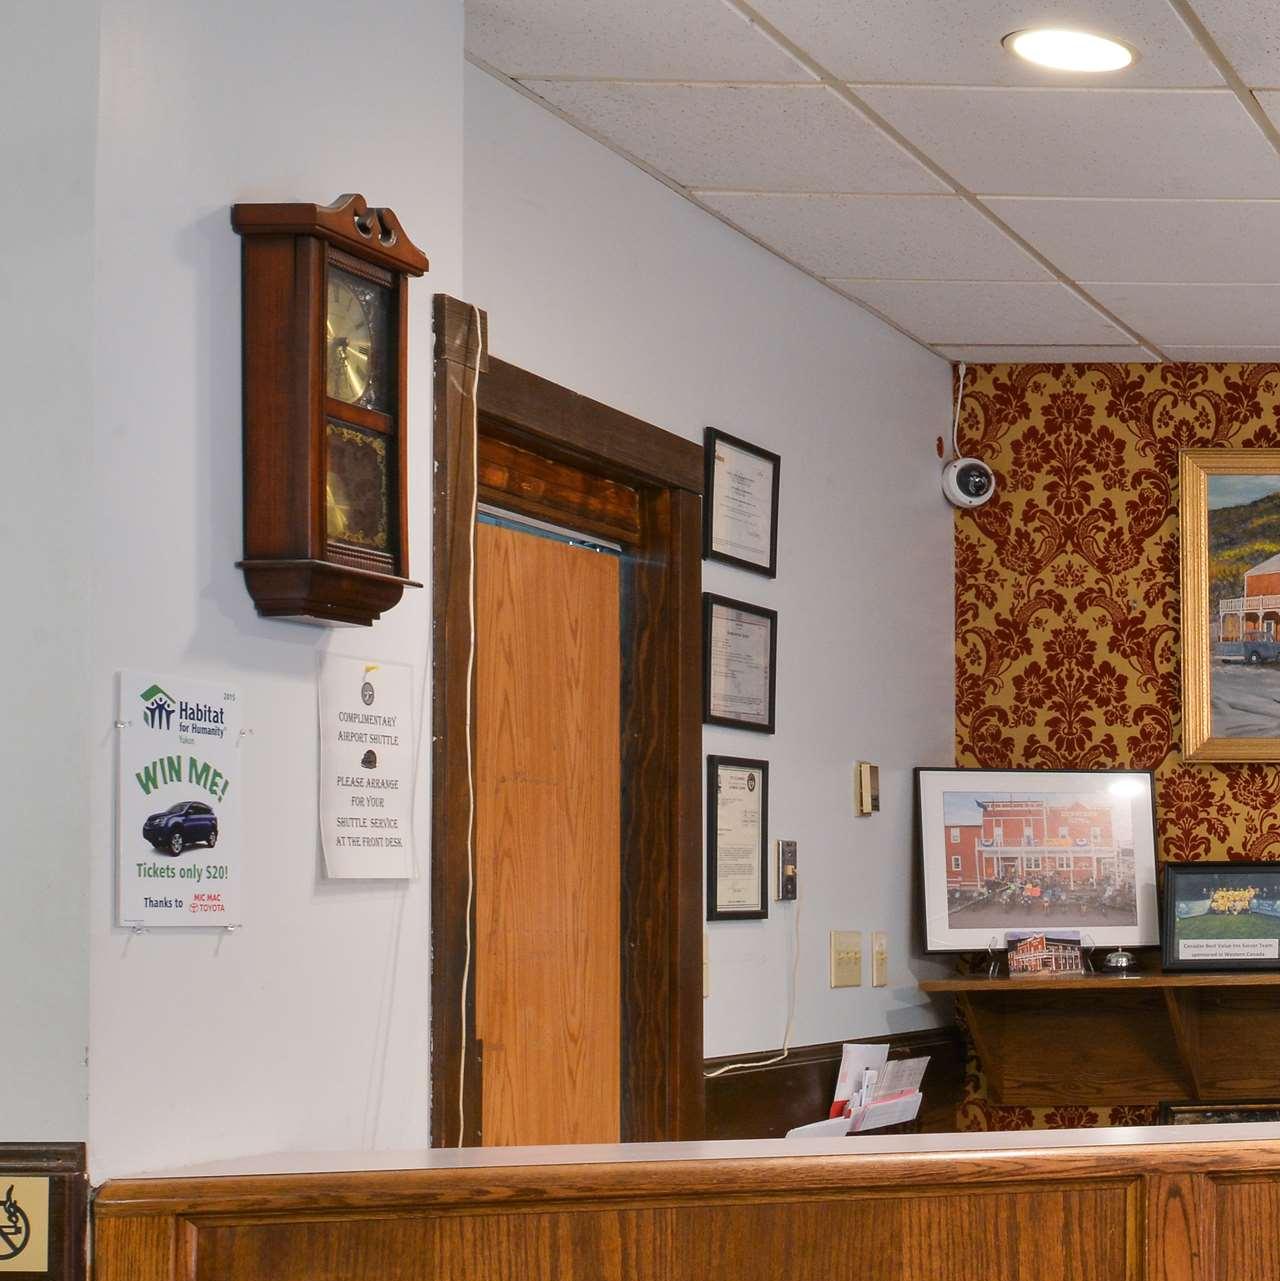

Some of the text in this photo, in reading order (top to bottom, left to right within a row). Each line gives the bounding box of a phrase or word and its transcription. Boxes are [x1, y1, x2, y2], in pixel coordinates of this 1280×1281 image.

[180, 701, 224, 724] Habitat
[338, 711, 396, 728] COMPLIMENTARY
[180, 722, 224, 739] for Humanity
[337, 730, 399, 746] AIRPORT SHUTTLE
[135, 755, 230, 803] WIN ME!
[336, 776, 399, 790] PLEASE ARRANGE
[351, 795, 384, 808] FOR YOUR
[336, 817, 399, 829] SHUTTLE SERVICE
[336, 837, 402, 848] AT THE FRONT DESK
[137, 863, 176, 879] Tickets
[179, 864, 203, 883] only
[144, 896, 184, 909] Thanks to
[199, 904, 225, 913] TOYOTA
